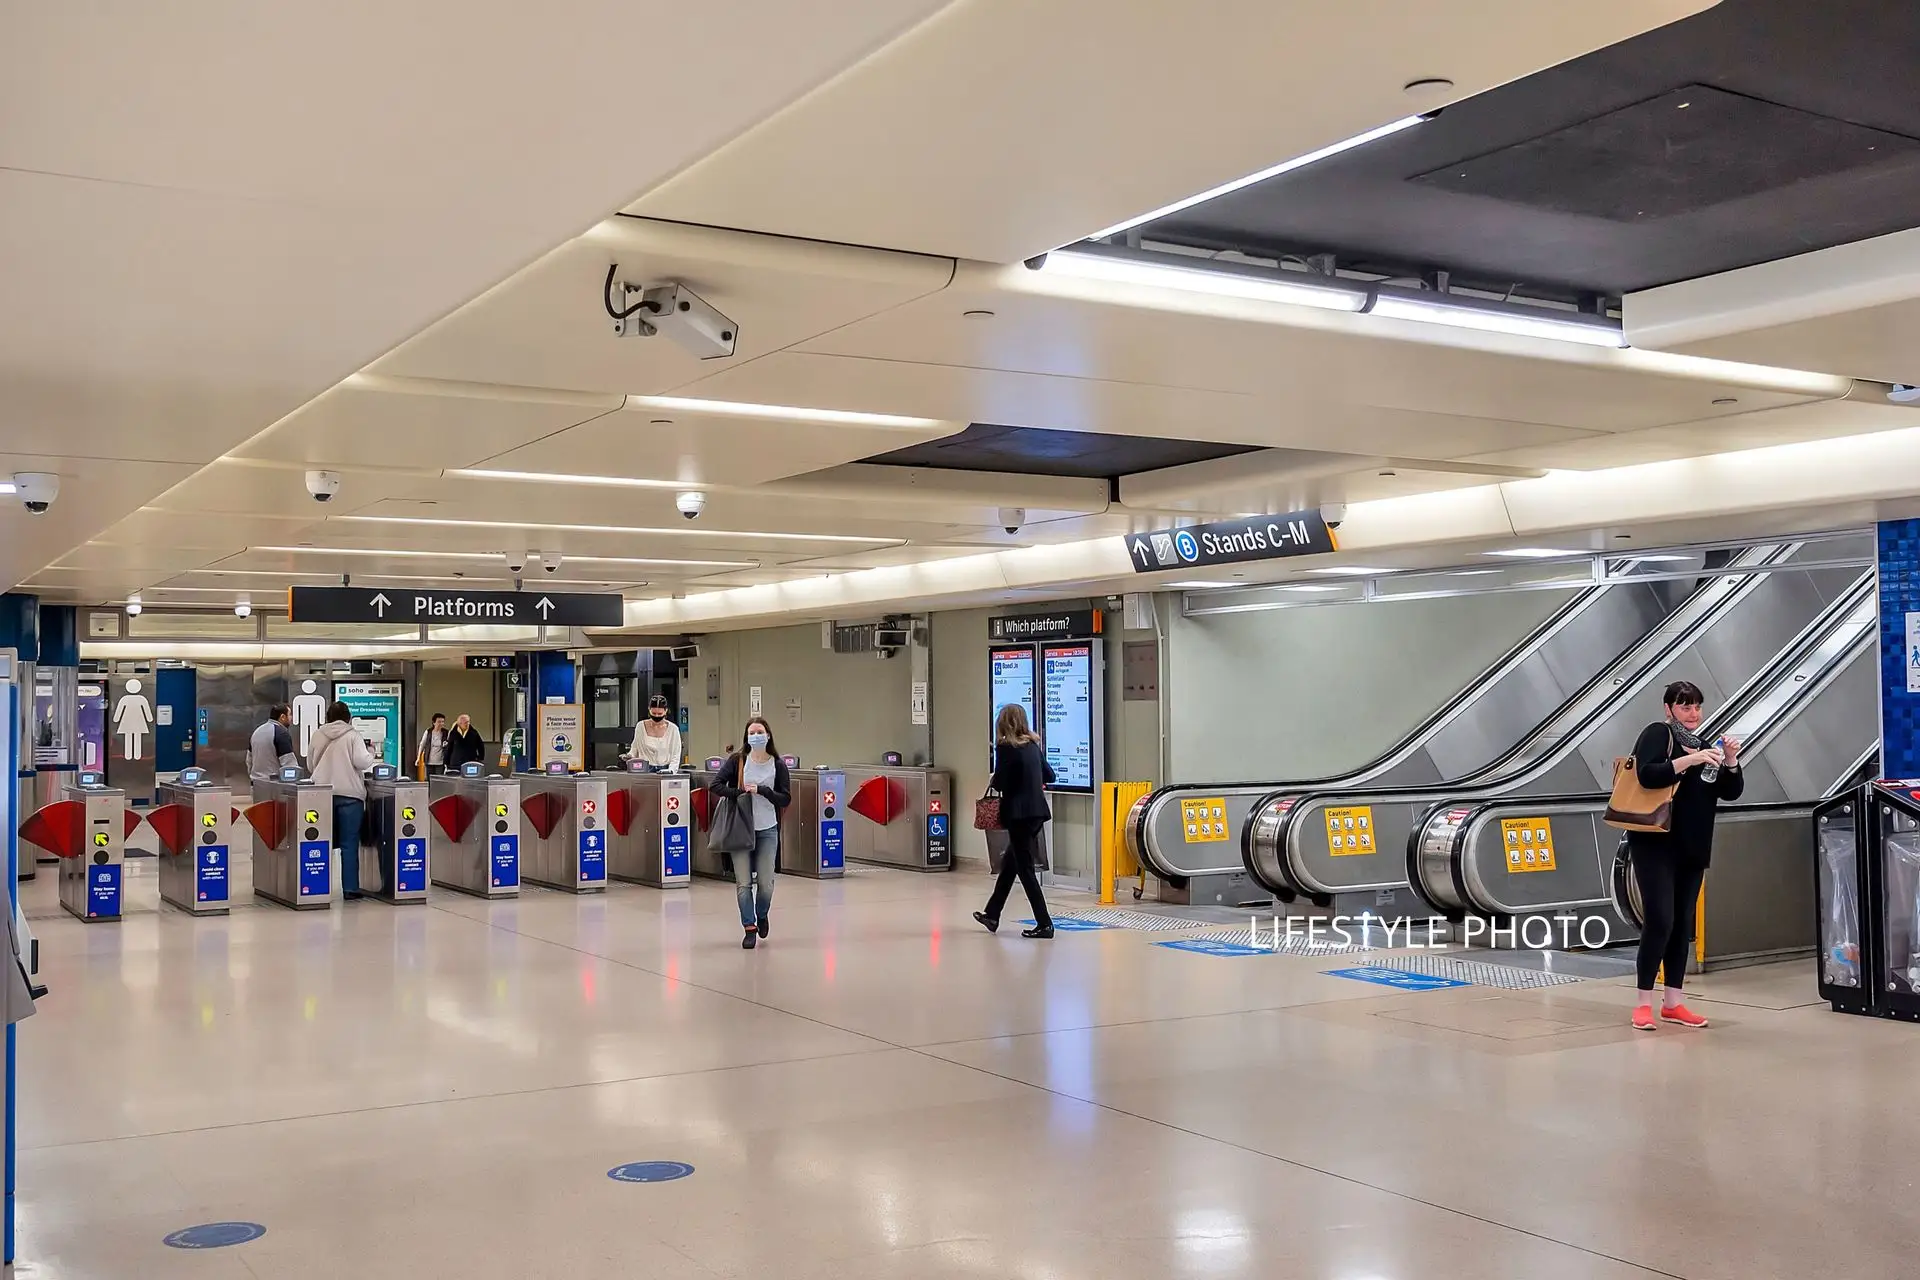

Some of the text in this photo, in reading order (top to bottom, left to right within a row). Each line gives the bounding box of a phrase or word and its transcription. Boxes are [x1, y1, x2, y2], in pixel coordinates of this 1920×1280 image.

[1202, 527, 1267, 556] Stands
[414, 596, 515, 617] Platforms
[1005, 619, 1029, 633] Which
[1030, 616, 1070, 634] platform?
[474, 658, 488, 667] 1-2
[1055, 660, 1073, 668] Cronulla
